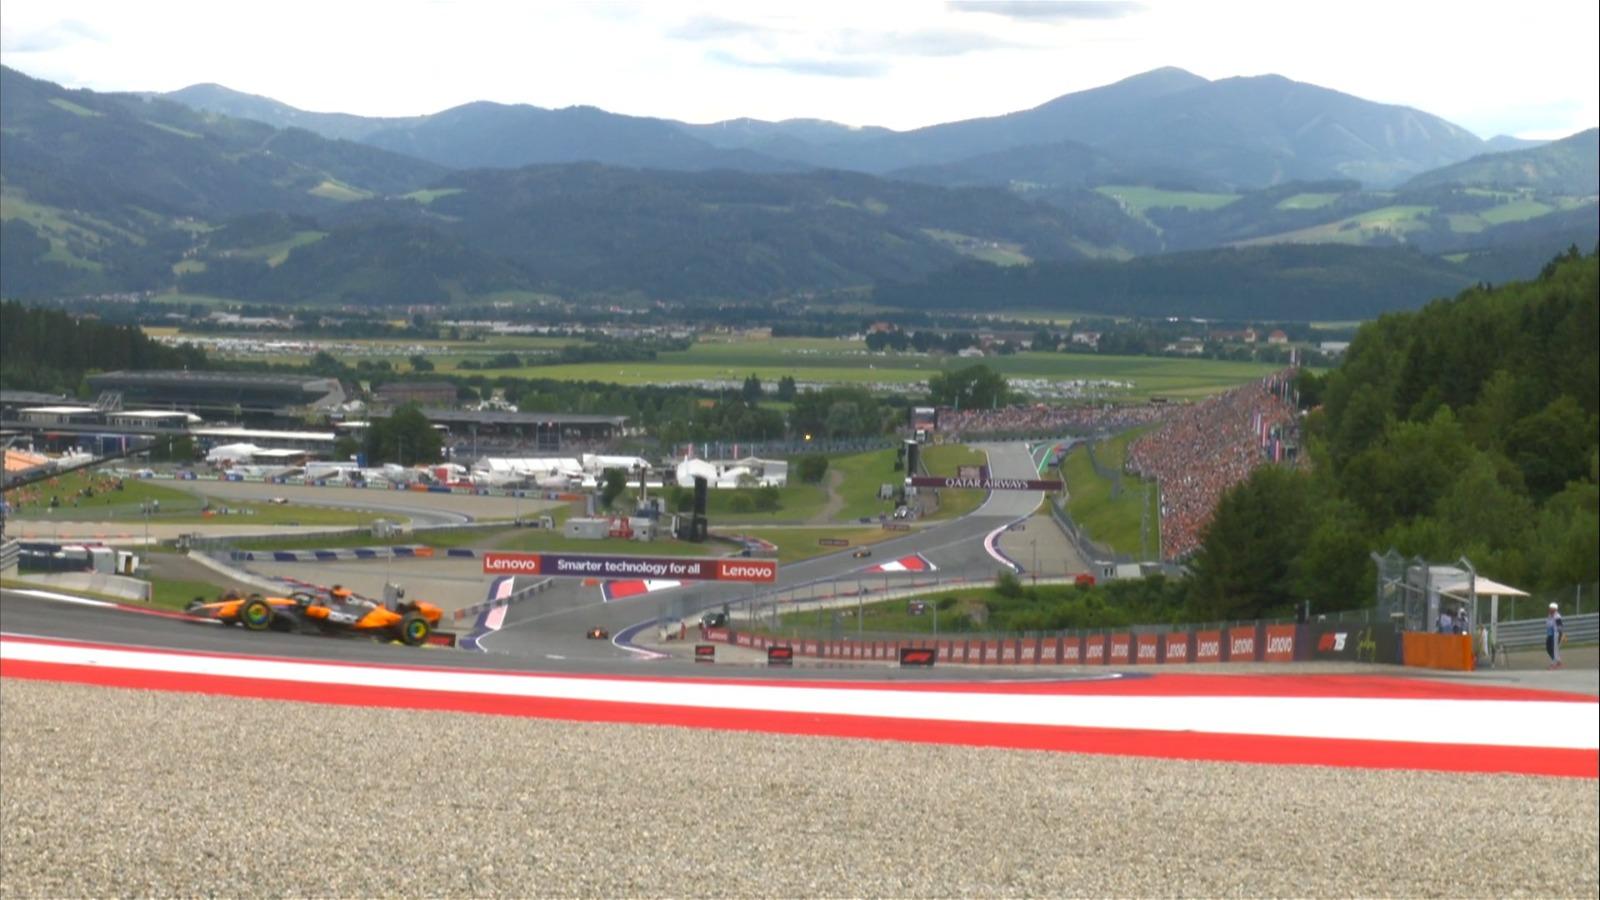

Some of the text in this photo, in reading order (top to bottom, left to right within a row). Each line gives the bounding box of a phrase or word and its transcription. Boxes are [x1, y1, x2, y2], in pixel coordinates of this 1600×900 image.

[945, 479, 1029, 489] QATAR AIRWAYS
[486, 557, 535, 570] Lenovo
[557, 559, 701, 576] Smarter technology for all
[722, 564, 772, 577] Lenovo
[1197, 638, 1220, 657] Lenovo
[1230, 636, 1254, 655] Lenovo
[1267, 633, 1293, 653] Lenovo
